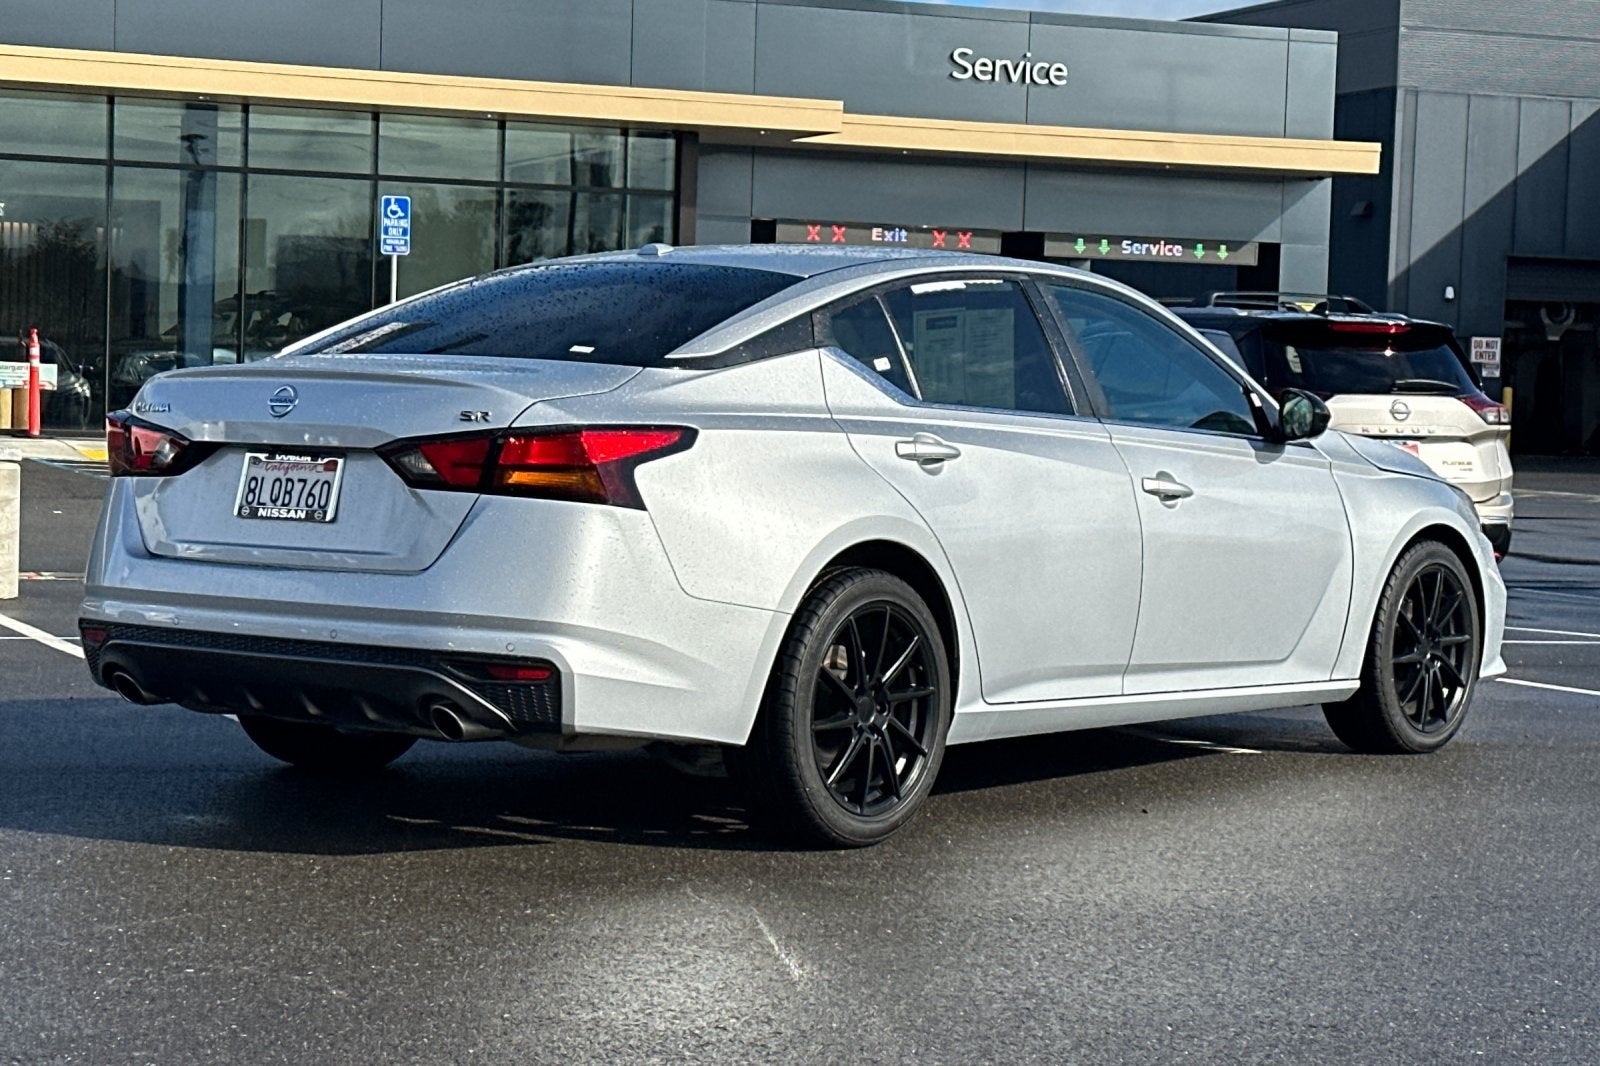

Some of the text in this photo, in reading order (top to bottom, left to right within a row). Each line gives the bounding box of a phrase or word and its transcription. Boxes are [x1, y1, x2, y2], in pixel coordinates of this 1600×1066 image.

[951, 47, 1069, 86] Service
[871, 227, 908, 242] Exit
[1121, 239, 1183, 257] Service
[1473, 339, 1499, 350] DO NOT
[1474, 350, 1497, 361] ENTER
[459, 410, 491, 423] SR
[245, 476, 332, 510] 8LQB760
[257, 507, 307, 519] NISSAN
